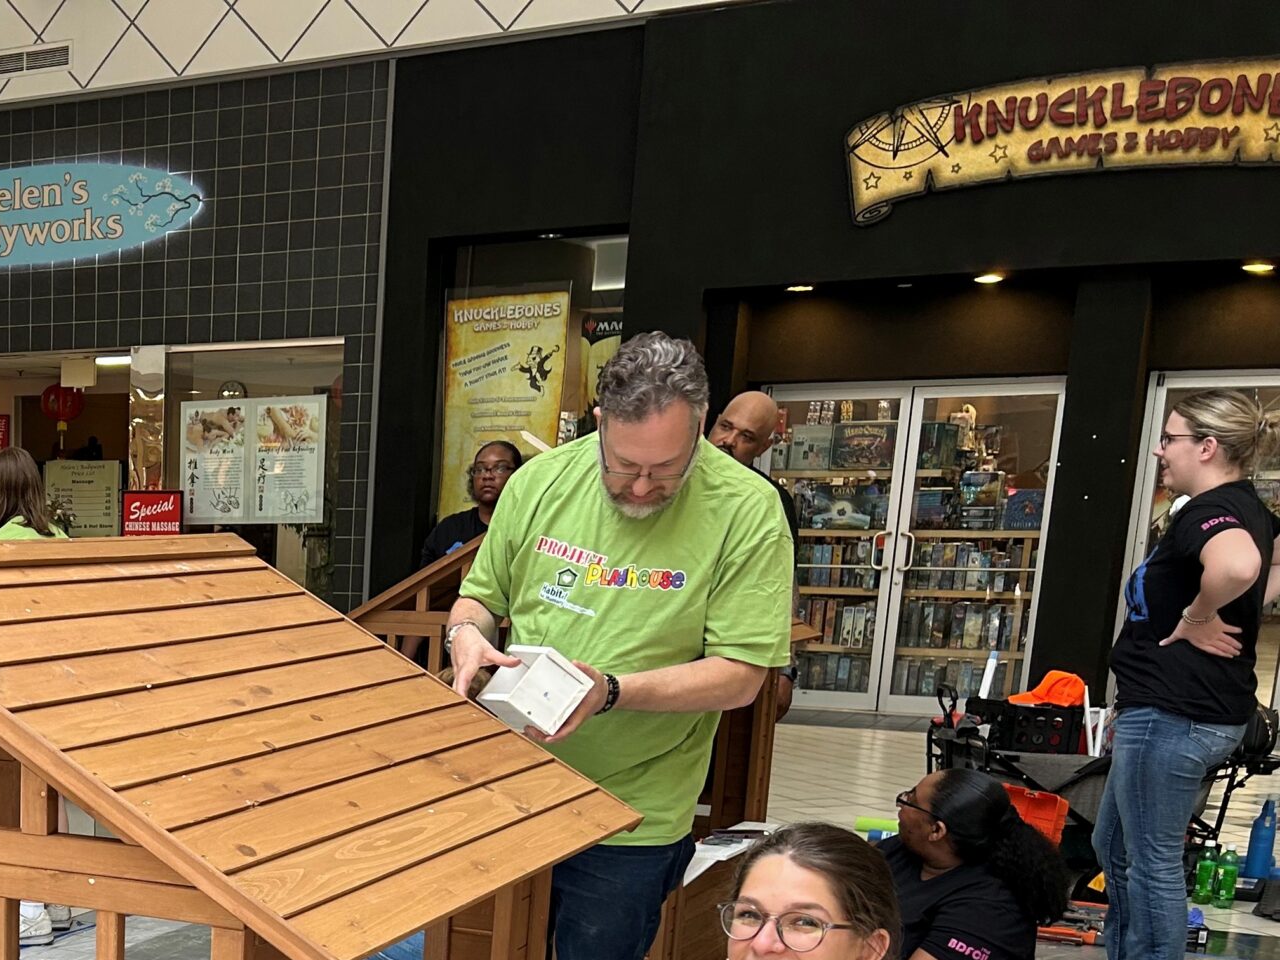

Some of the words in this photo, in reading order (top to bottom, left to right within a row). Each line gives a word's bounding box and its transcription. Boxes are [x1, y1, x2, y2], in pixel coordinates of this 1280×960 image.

[1027, 130, 1118, 164] GAMES
[1145, 125, 1241, 153] HOBBY
[454, 303, 562, 323] KNUCKLEBONES
[473, 322, 501, 332] GAMES
[832, 487, 856, 495] CATAN
[130, 495, 174, 521] Special
[125, 521, 150, 531] CHINESE
[151, 521, 180, 531] MASSAGE
[536, 537, 607, 566] PROJECT
